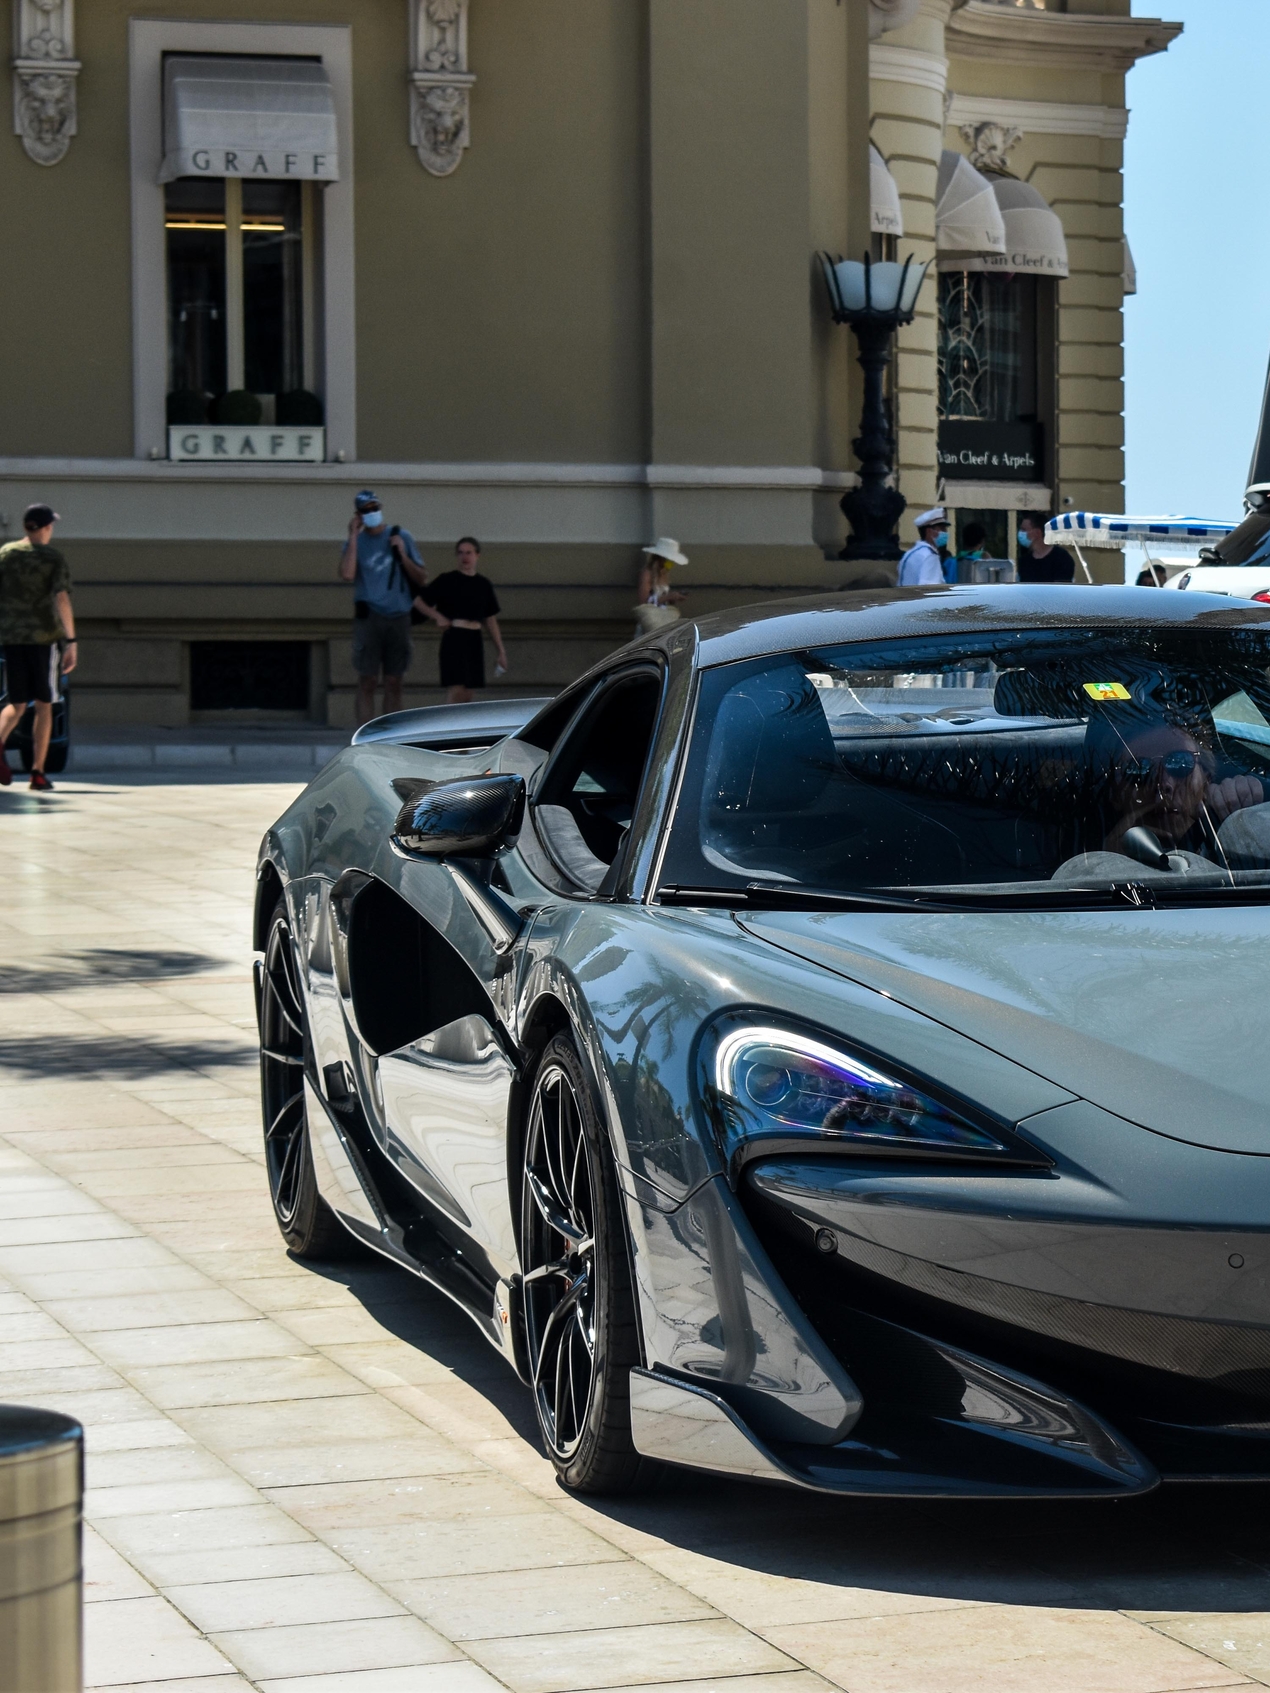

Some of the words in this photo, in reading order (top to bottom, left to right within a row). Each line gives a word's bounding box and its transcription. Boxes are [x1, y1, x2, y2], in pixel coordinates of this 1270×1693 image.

[191, 151, 327, 175] GRAFF
[1011, 252, 1045, 268] Cleef
[1046, 258, 1054, 269] &
[181, 433, 313, 456] GRAFF
[959, 449, 989, 466] Cleef
[991, 454, 999, 466] &
[1001, 451, 1035, 470] Arpels
